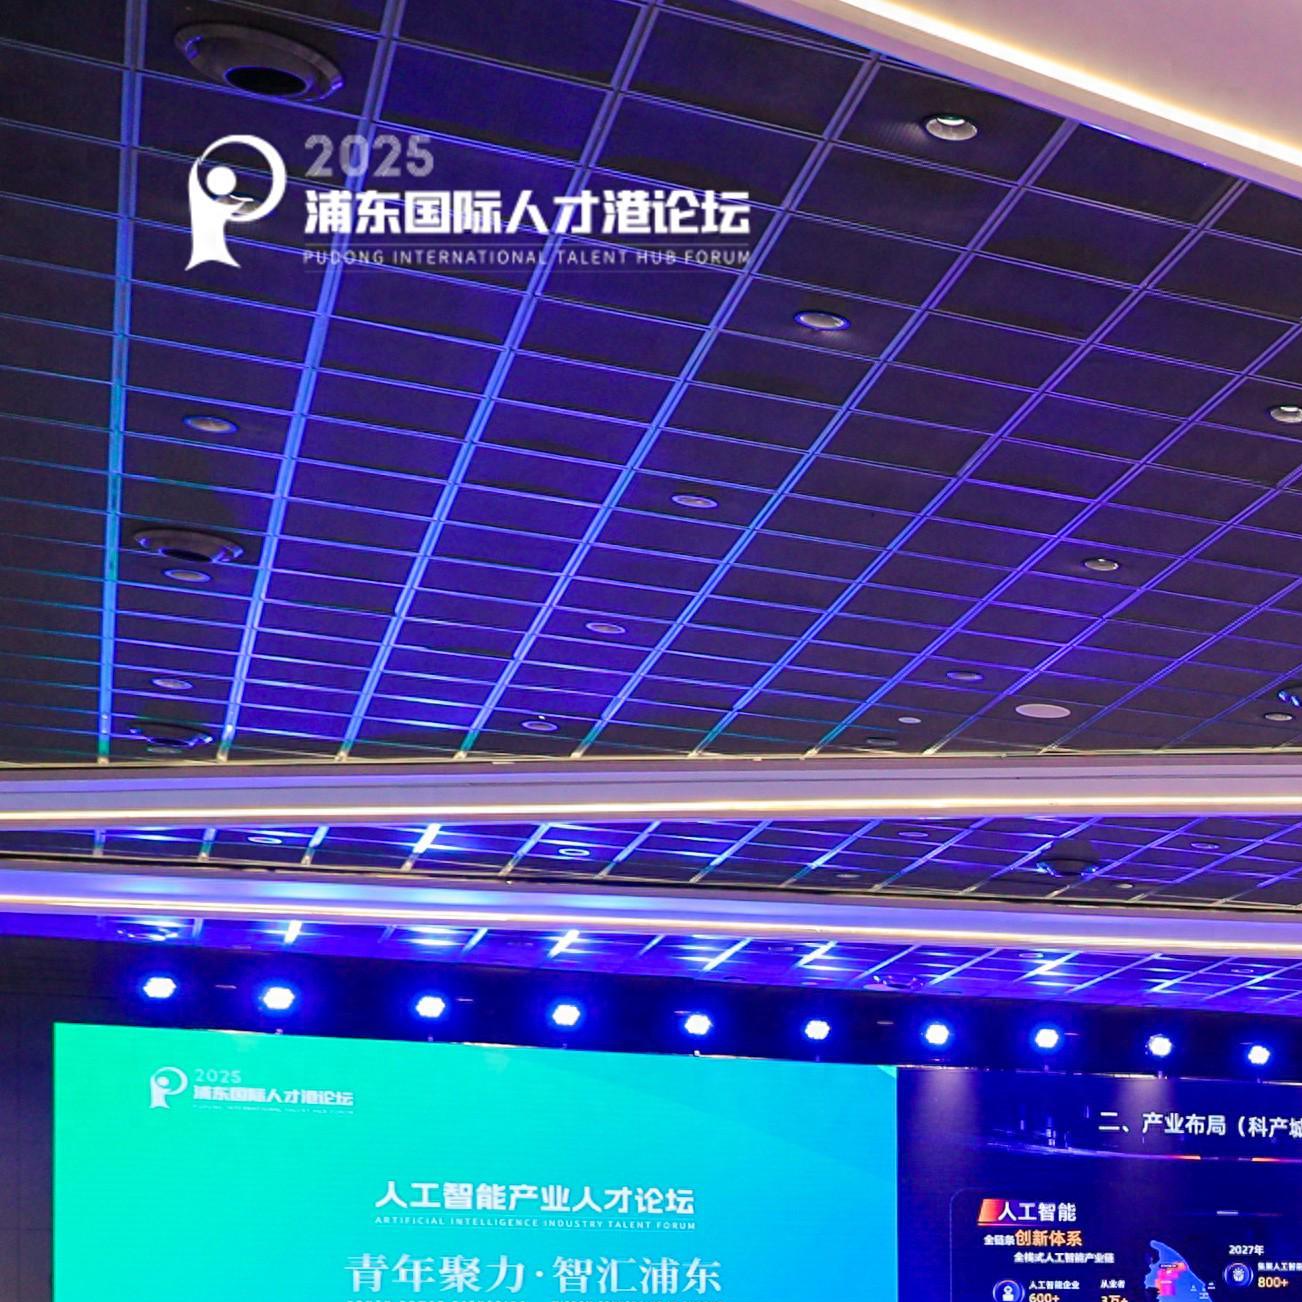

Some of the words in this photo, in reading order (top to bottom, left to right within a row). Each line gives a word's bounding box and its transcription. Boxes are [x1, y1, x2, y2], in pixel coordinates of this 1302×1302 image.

[195, 1068, 242, 1084] 2025
[375, 1180, 695, 1215] 人工智能产业人才论坛
[998, 1201, 1077, 1222] 人工智能
[375, 1216, 445, 1225] ARTIFICIAL
[450, 1217, 539, 1227] INTELLIGENCE
[544, 1219, 602, 1228] INDUSTRY
[608, 1220, 651, 1229] TALENT
[656, 1221, 696, 1230] FORUM
[1229, 1245, 1264, 1256] 2027年
[1029, 1280, 1080, 1290] 人工智能企业
[1100, 1280, 1126, 1289] 从业者
[1257, 1277, 1289, 1288] 800+
